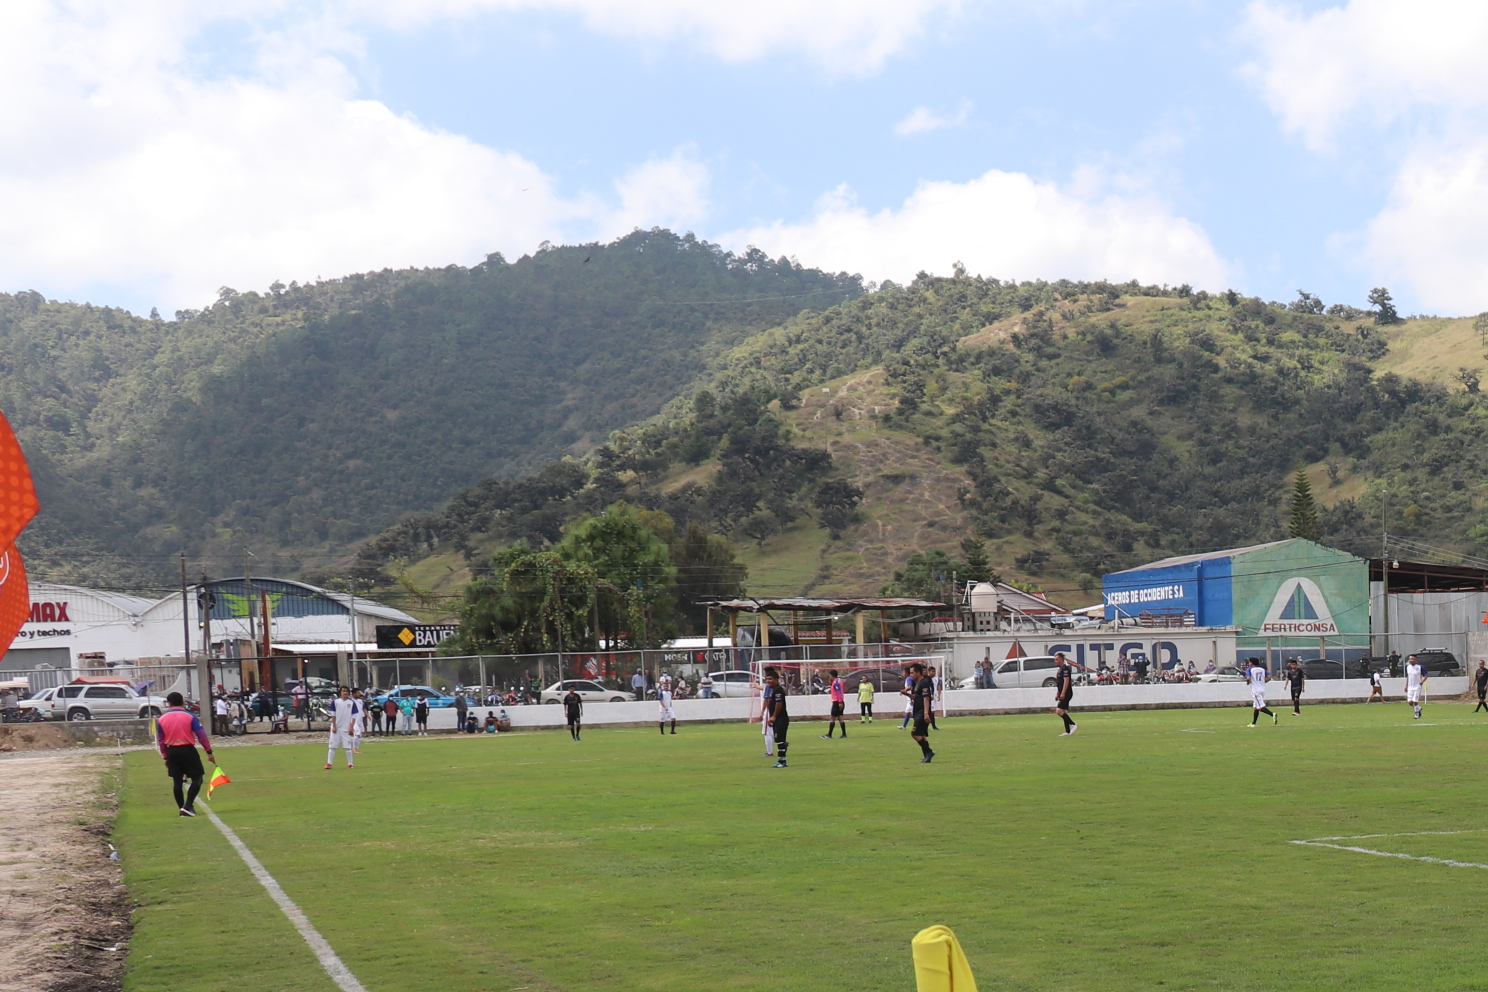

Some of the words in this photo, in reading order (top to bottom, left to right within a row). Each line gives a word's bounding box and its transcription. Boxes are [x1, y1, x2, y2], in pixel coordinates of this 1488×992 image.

[1107, 591, 1129, 605] ACEROS
[1130, 589, 1139, 603] DE
[1139, 586, 1173, 602] OCCIDENTE
[1263, 623, 1336, 632] FERTICONSA
[28, 630, 35, 639] y
[37, 628, 71, 637] techos
[1255, 672, 1263, 681] 17
